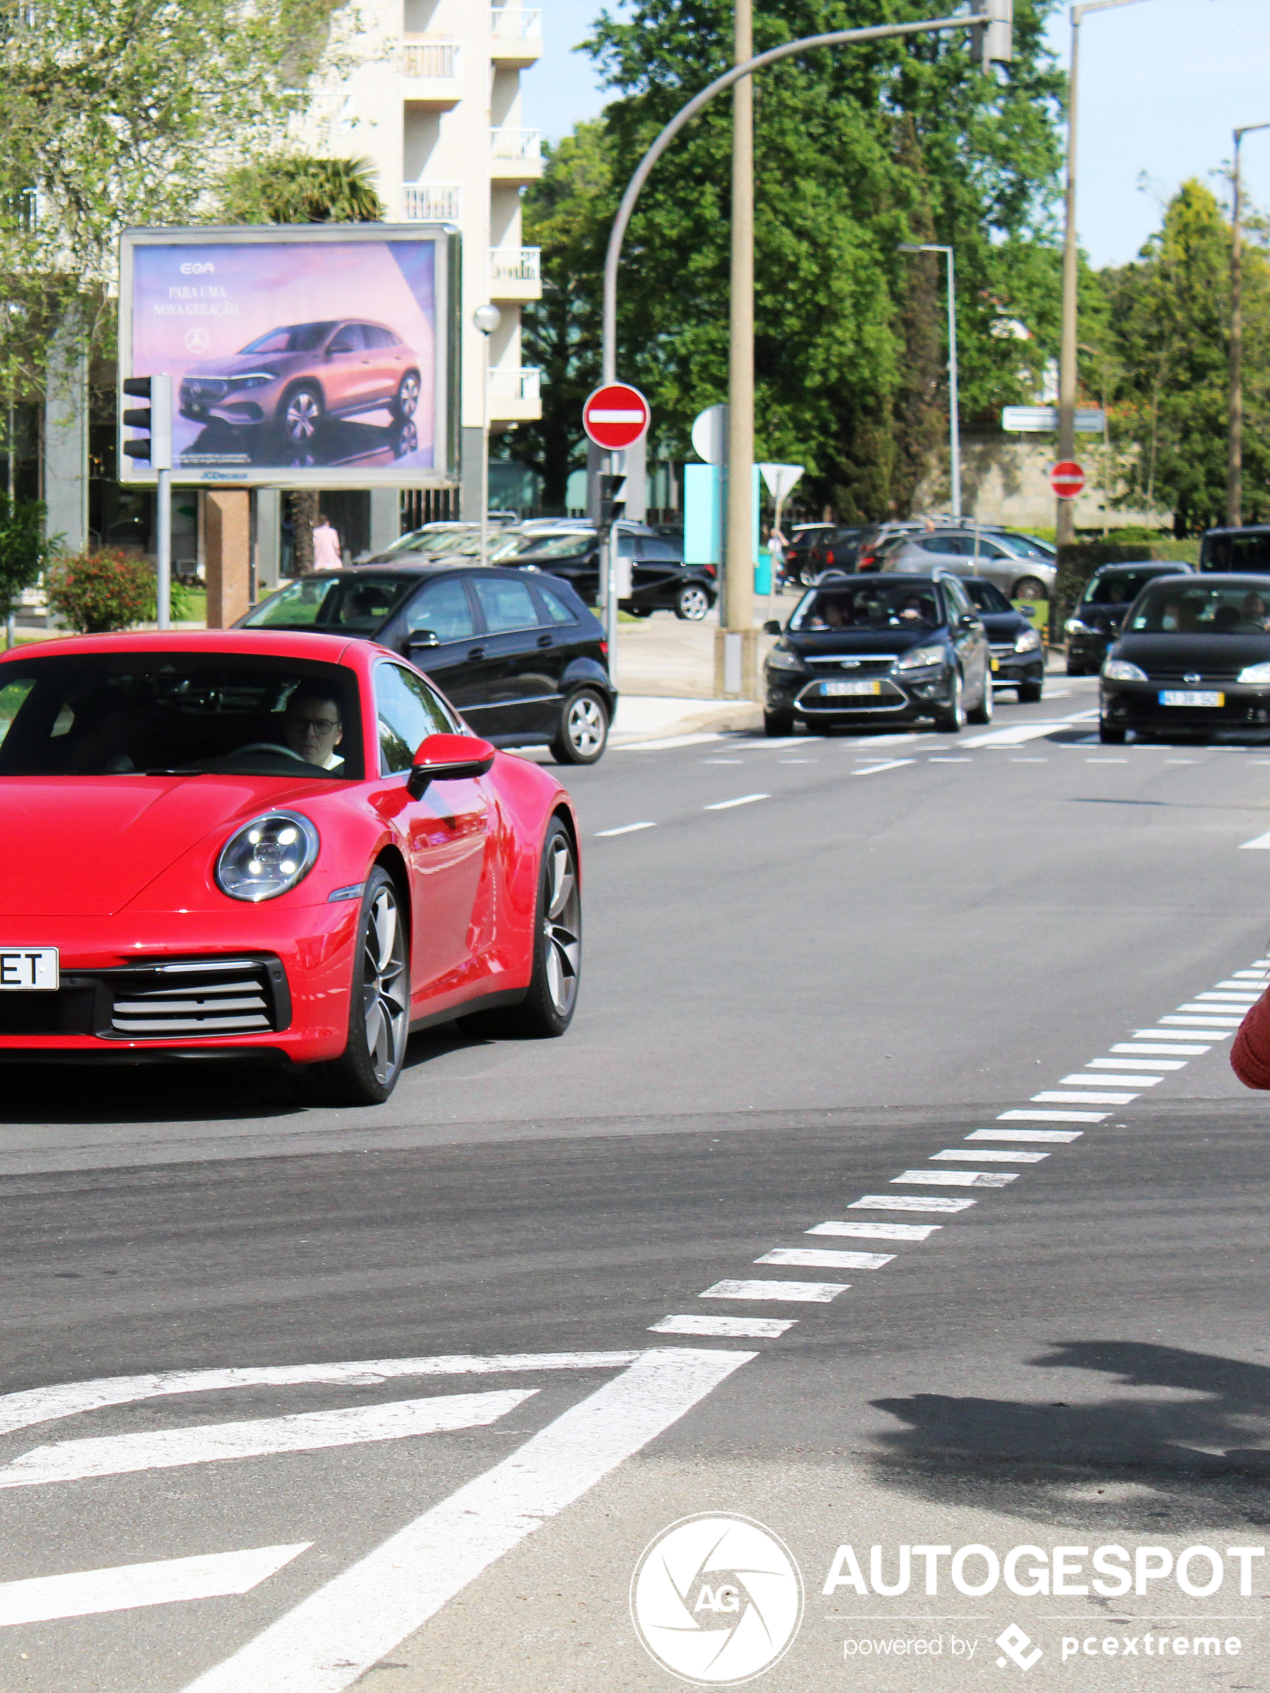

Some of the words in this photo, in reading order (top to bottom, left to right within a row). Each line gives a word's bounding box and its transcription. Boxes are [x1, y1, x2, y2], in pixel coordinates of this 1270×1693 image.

[179, 262, 215, 275] EQA
[169, 286, 198, 299] PARA
[199, 286, 227, 299] UMA
[153, 304, 184, 317] NOVA
